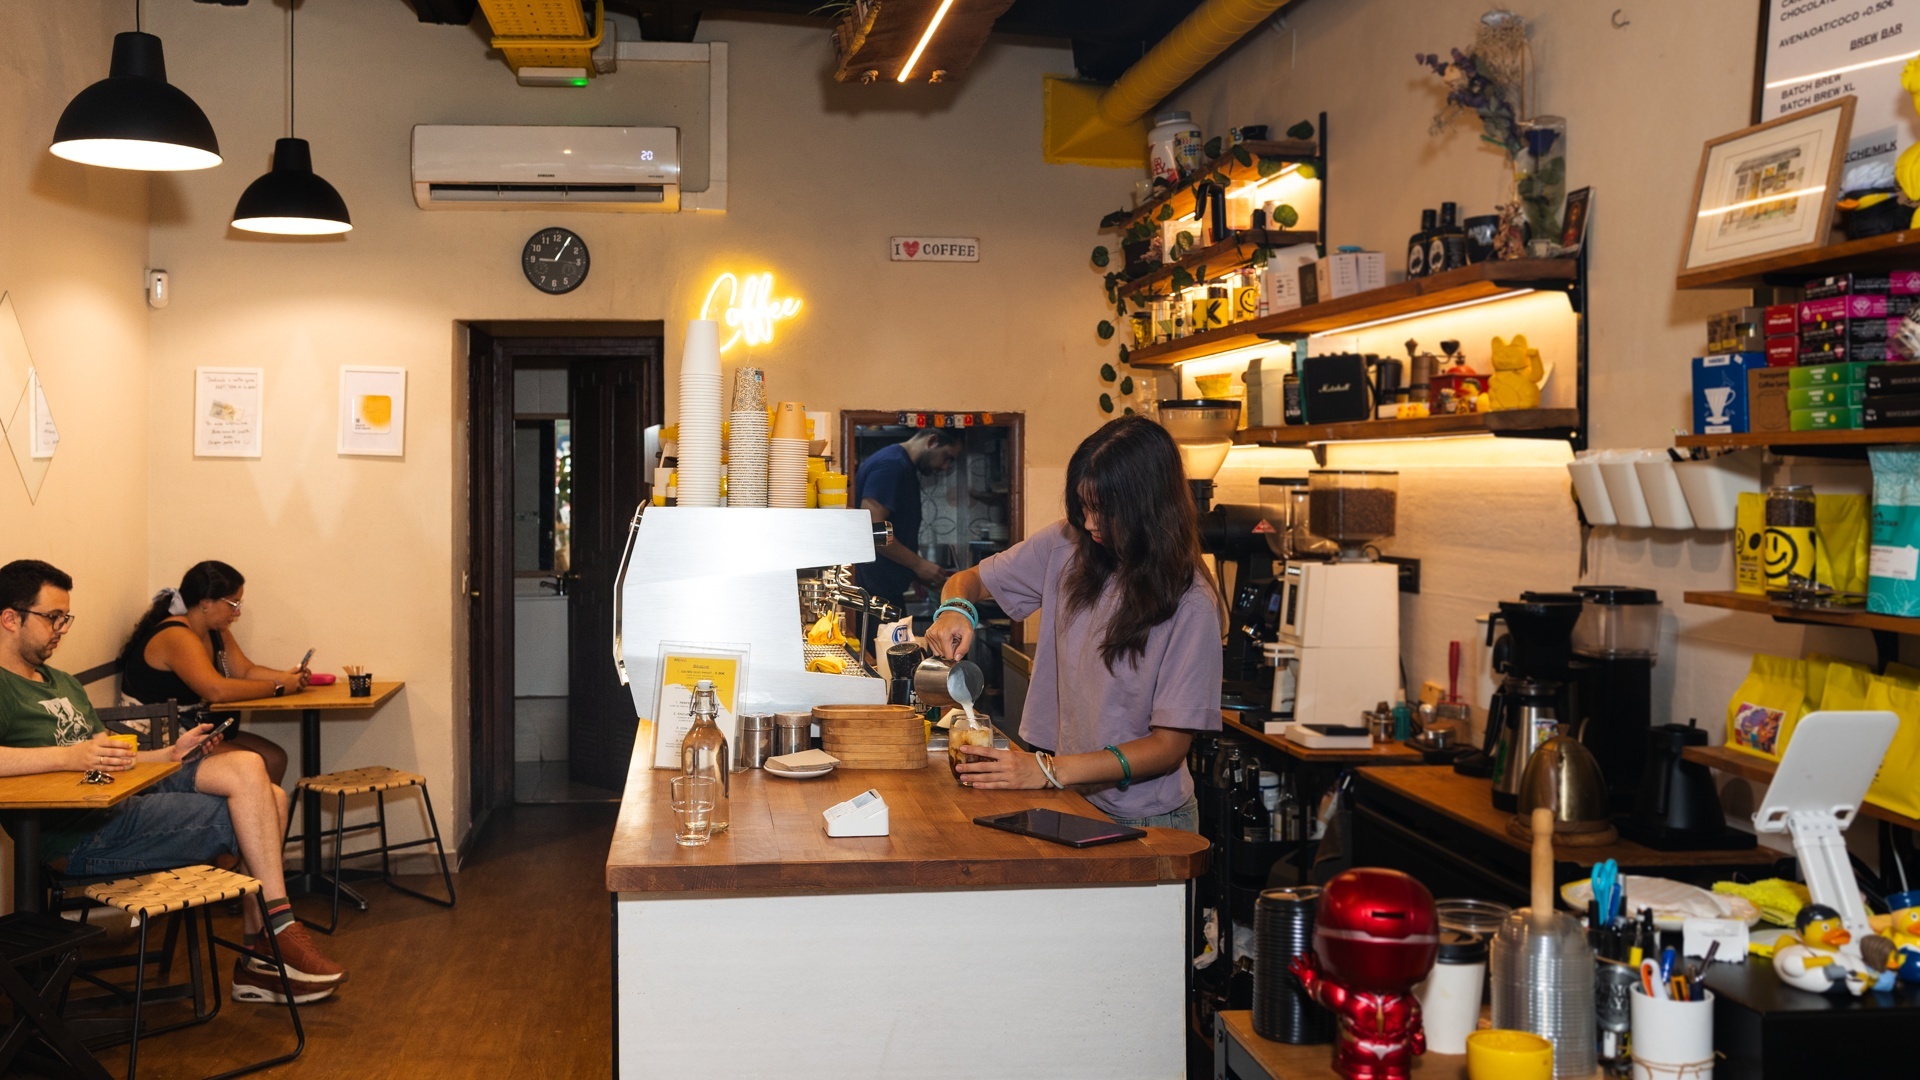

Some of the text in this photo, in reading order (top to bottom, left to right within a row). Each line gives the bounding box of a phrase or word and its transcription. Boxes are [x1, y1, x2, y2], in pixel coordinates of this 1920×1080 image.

[1780, 0, 1837, 21] CHOCOLA
[1850, 22, 1903, 50] BREW BAR
[1781, 74, 1841, 100] BATCH BREW
[1780, 82, 1856, 113] BATCH BREW XL
[640, 150, 654, 161] 20
[1844, 139, 1897, 163] ECHE/MILK
[542, 236, 550, 245] 11
[553, 234, 562, 243] 12
[532, 244, 542, 252] 10
[573, 247, 579, 255] 2
[894, 243, 976, 257] I COFFEE
[530, 255, 536, 263] 9
[576, 258, 581, 266] 3
[540, 275, 546, 283] 7
[551, 279, 557, 287] 6
[563, 277, 569, 285] 5
[700, 271, 802, 354] Coffee
